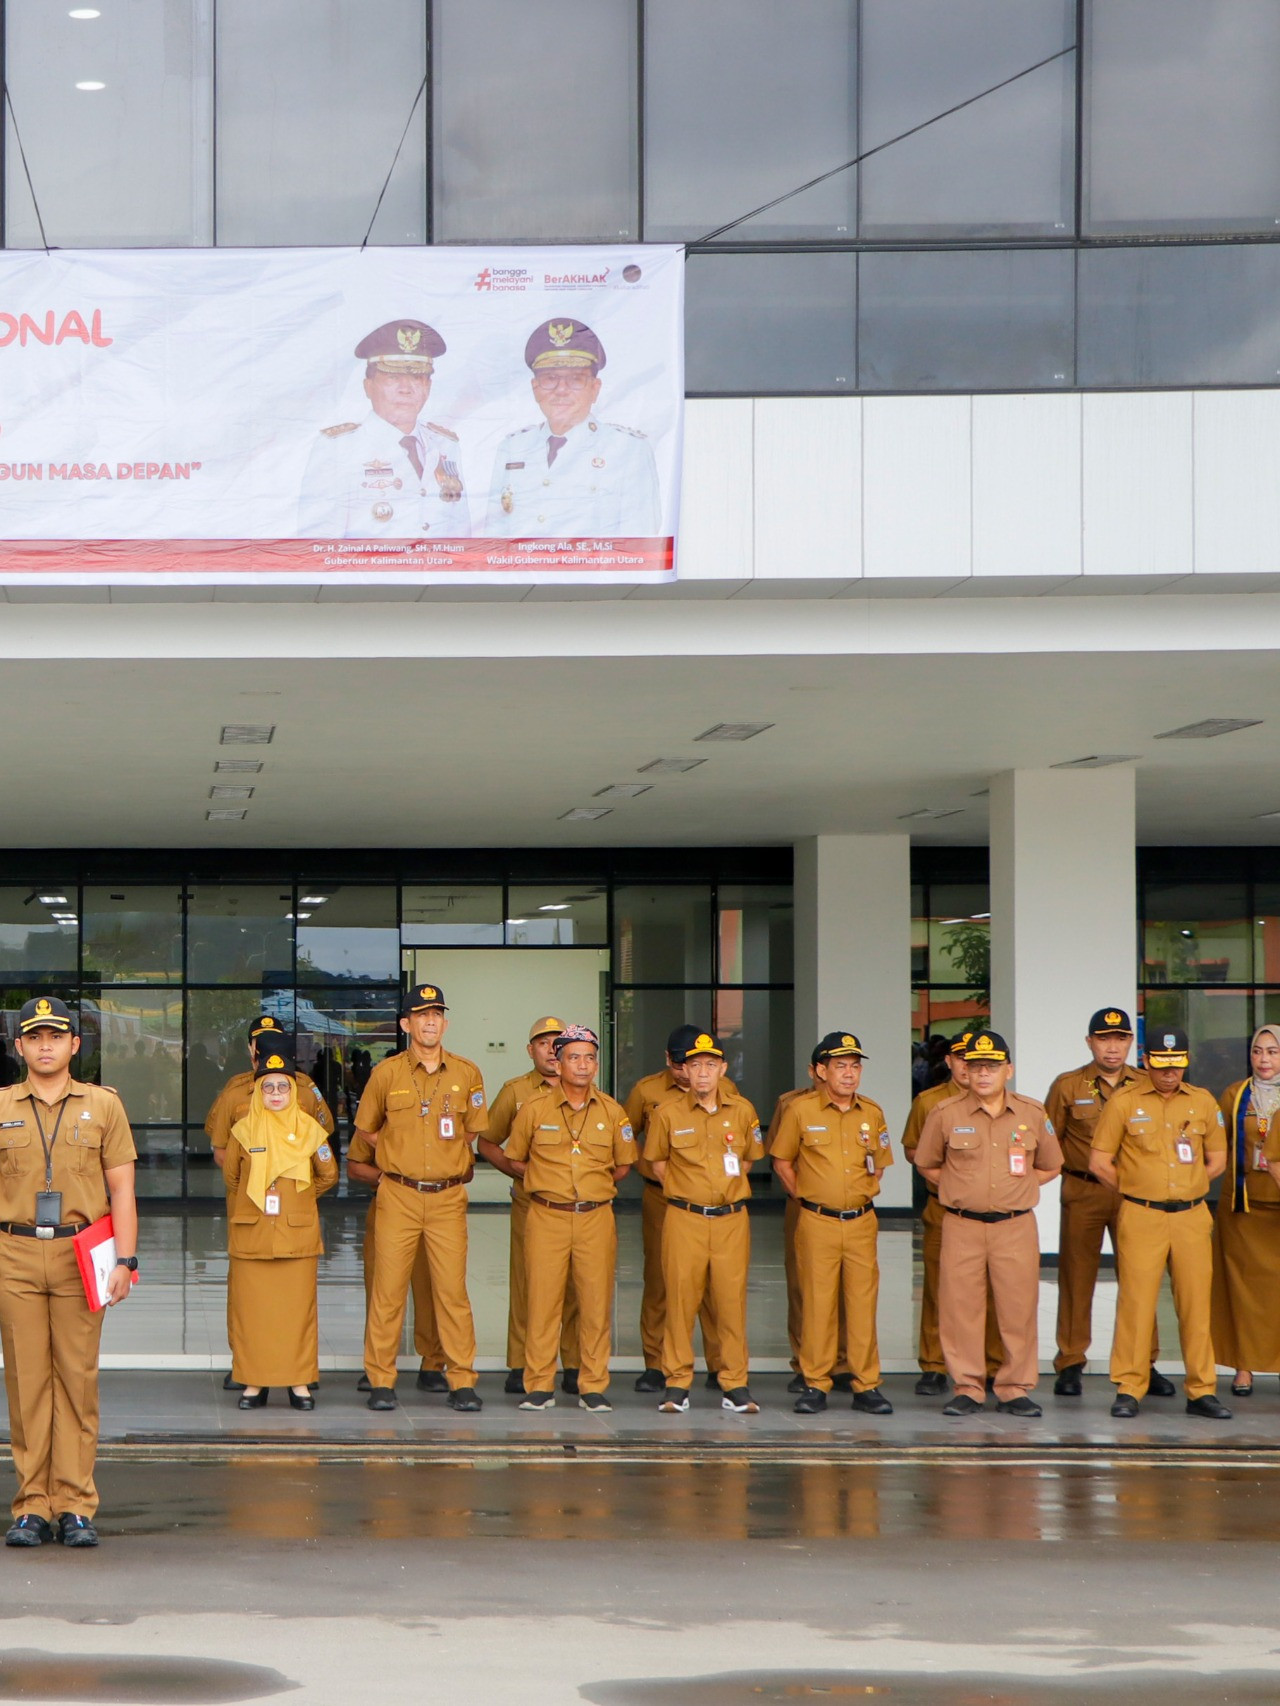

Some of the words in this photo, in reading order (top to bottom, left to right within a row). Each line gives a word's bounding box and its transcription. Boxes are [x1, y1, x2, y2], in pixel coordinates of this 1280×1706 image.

[492, 268, 527, 277] bangga
[492, 275, 533, 285] melayani
[544, 274, 607, 284] BerAKHLAK
[48, 462, 113, 481] MASA
[313, 545, 324, 553] Dr.
[327, 545, 336, 553] H.
[338, 544, 364, 553] Zainal
[373, 544, 413, 554] Paliwang,
[433, 544, 465, 553] M.Hum
[518, 542, 556, 553] Ingkong
[557, 542, 575, 551] Ala,
[593, 542, 613, 551] M.Si
[324, 557, 369, 565] Gubernur
[371, 556, 425, 565] Kalimantan
[426, 557, 453, 565] Utara
[486, 556, 513, 564] Wakil
[514, 556, 560, 564] Gubernur
[561, 556, 616, 564] Kalimantan
[617, 556, 644, 564] Utara
